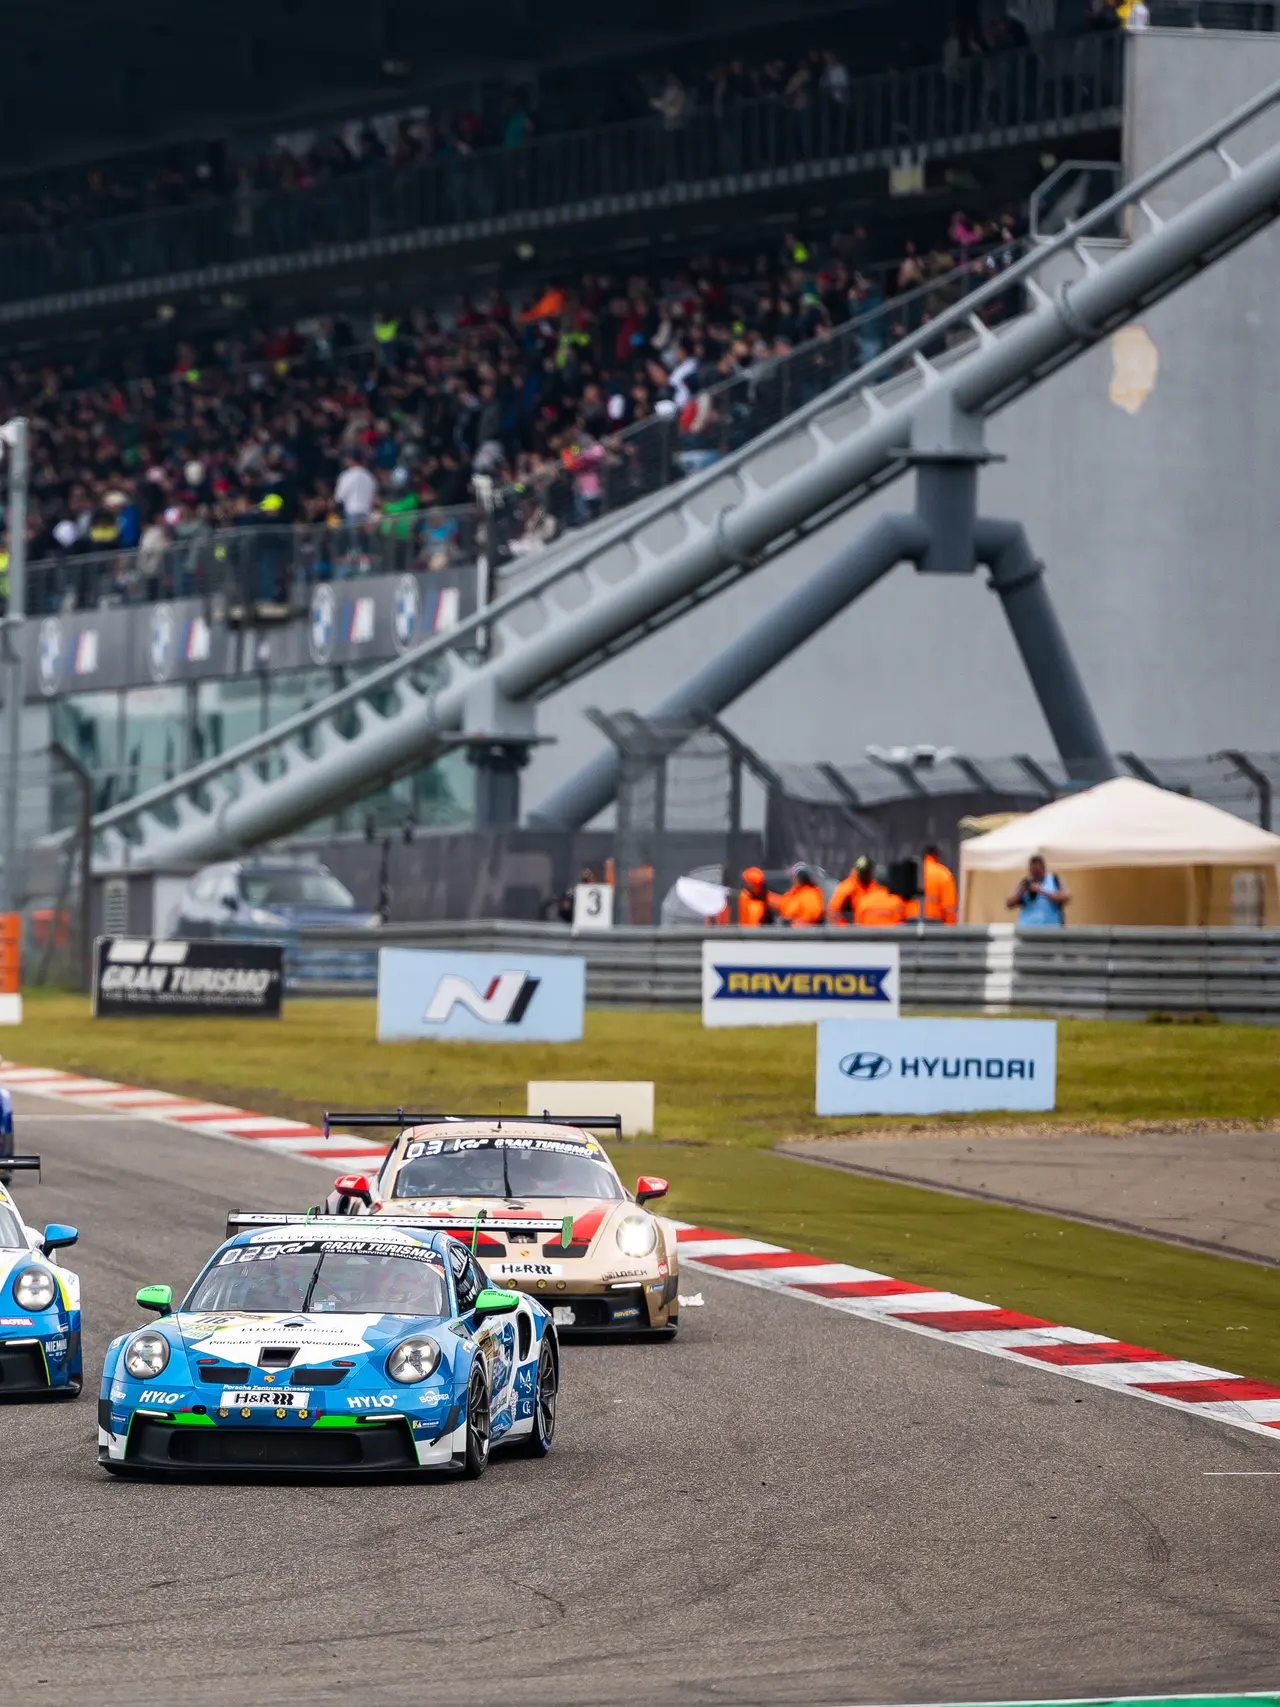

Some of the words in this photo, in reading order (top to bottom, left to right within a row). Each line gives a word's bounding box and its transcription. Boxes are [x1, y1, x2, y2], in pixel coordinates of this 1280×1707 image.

[587, 889, 601, 915] 3
[101, 965, 167, 991] GRAN
[169, 968, 271, 994] TURISMO
[727, 972, 877, 997] RAVENOL
[901, 1058, 1035, 1081] HYUNDAI
[494, 1138, 533, 1148] GRAN
[535, 1140, 594, 1156] TURISMO
[320, 1241, 363, 1250] GRAN
[368, 1243, 437, 1259] TURISMO
[501, 1264, 536, 1274] H&R
[0, 1318, 33, 1326] MOTUL
[301, 1339, 360, 1347] Wiesbaden
[140, 1390, 179, 1405] HYLO
[235, 1392, 272, 1405] H&R
[347, 1394, 395, 1409] HYLO
